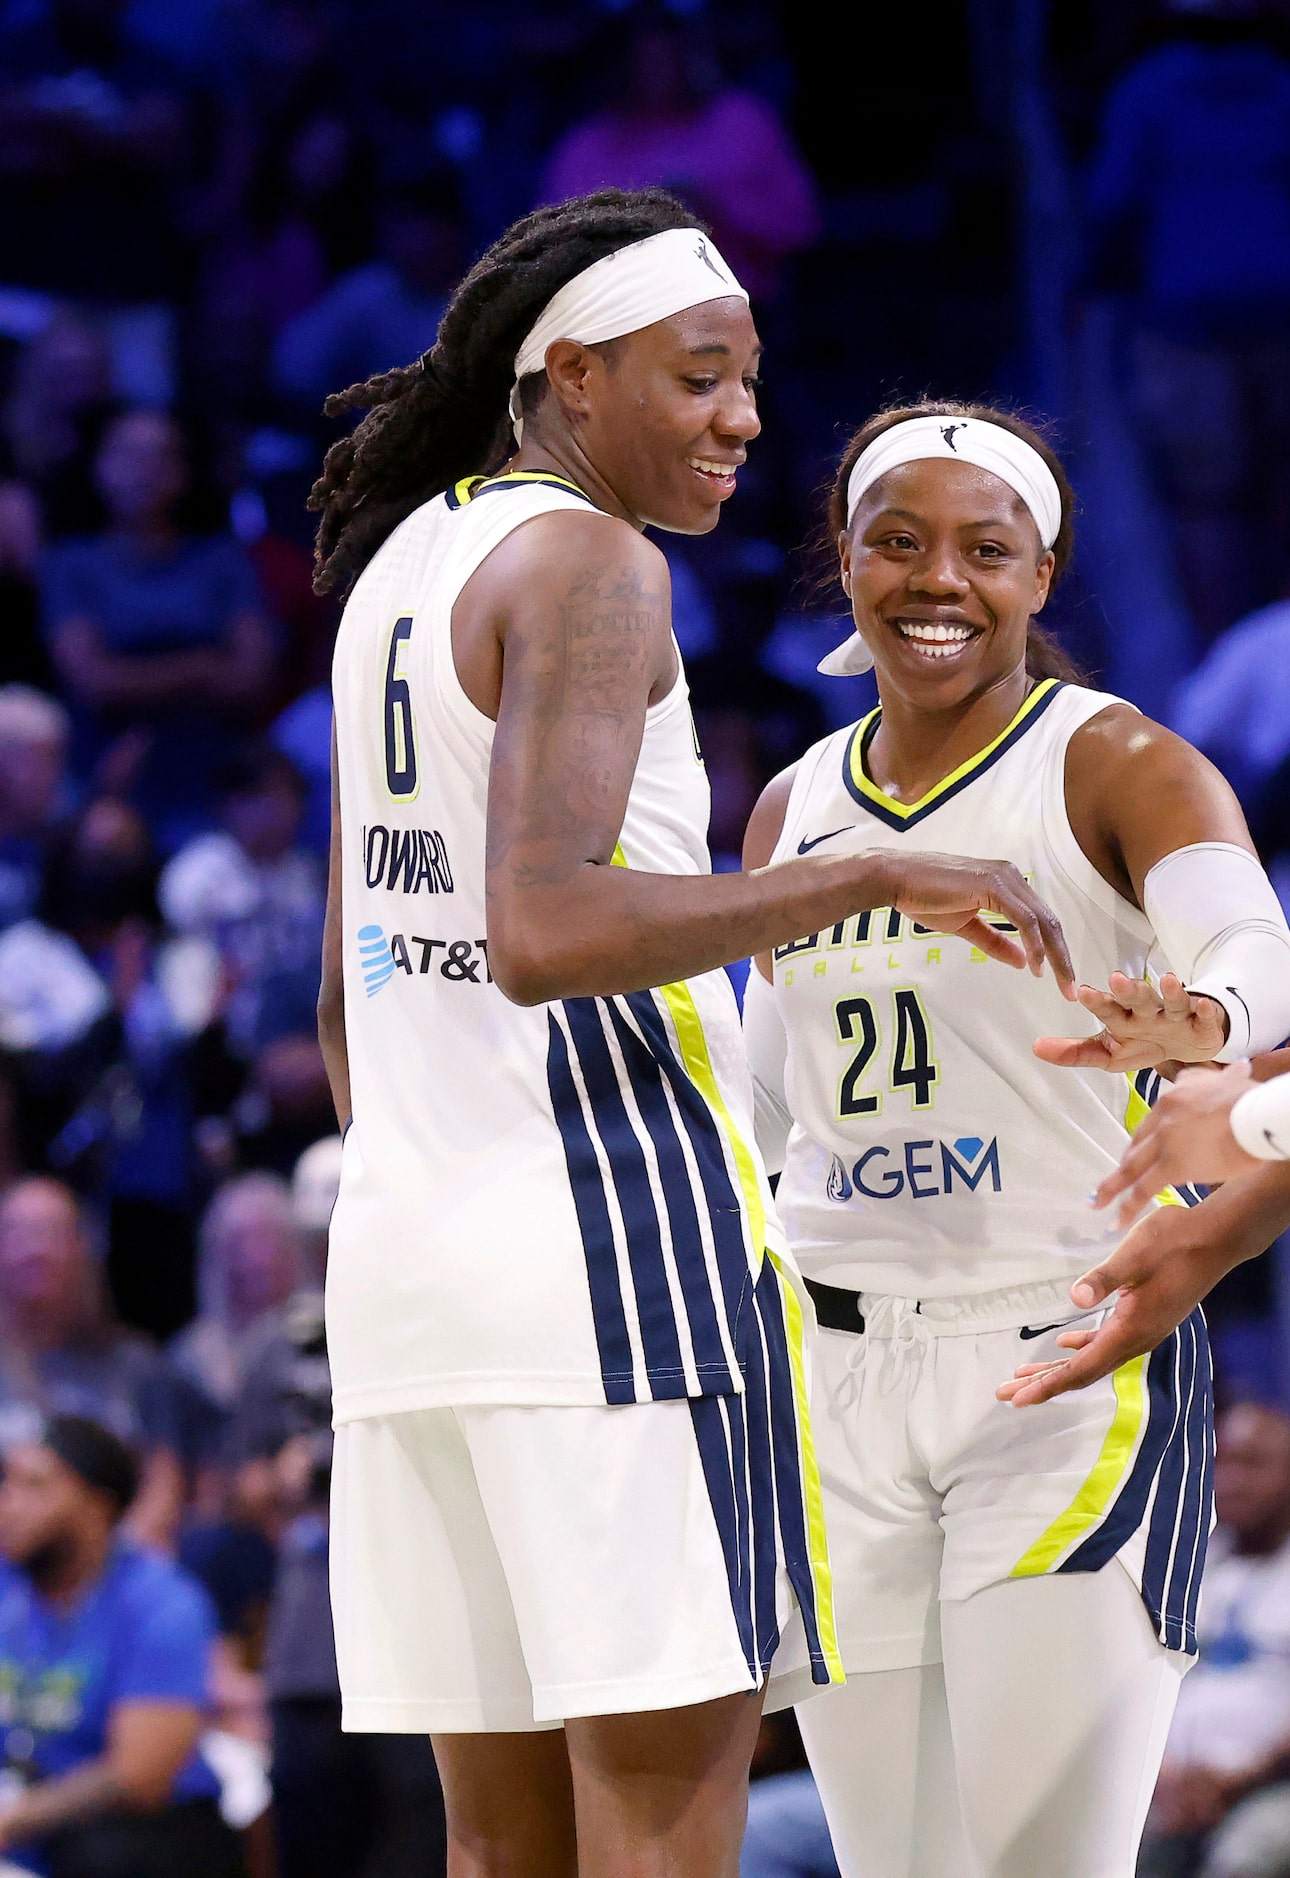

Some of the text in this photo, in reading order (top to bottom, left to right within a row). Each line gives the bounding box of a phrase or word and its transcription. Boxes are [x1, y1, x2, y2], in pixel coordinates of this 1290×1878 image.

[385, 611, 421, 803] 6
[363, 825, 454, 894] OWARD
[784, 945, 988, 986] DALLAS
[831, 985, 942, 1121] 24
[851, 1136, 1002, 1199] GEM
